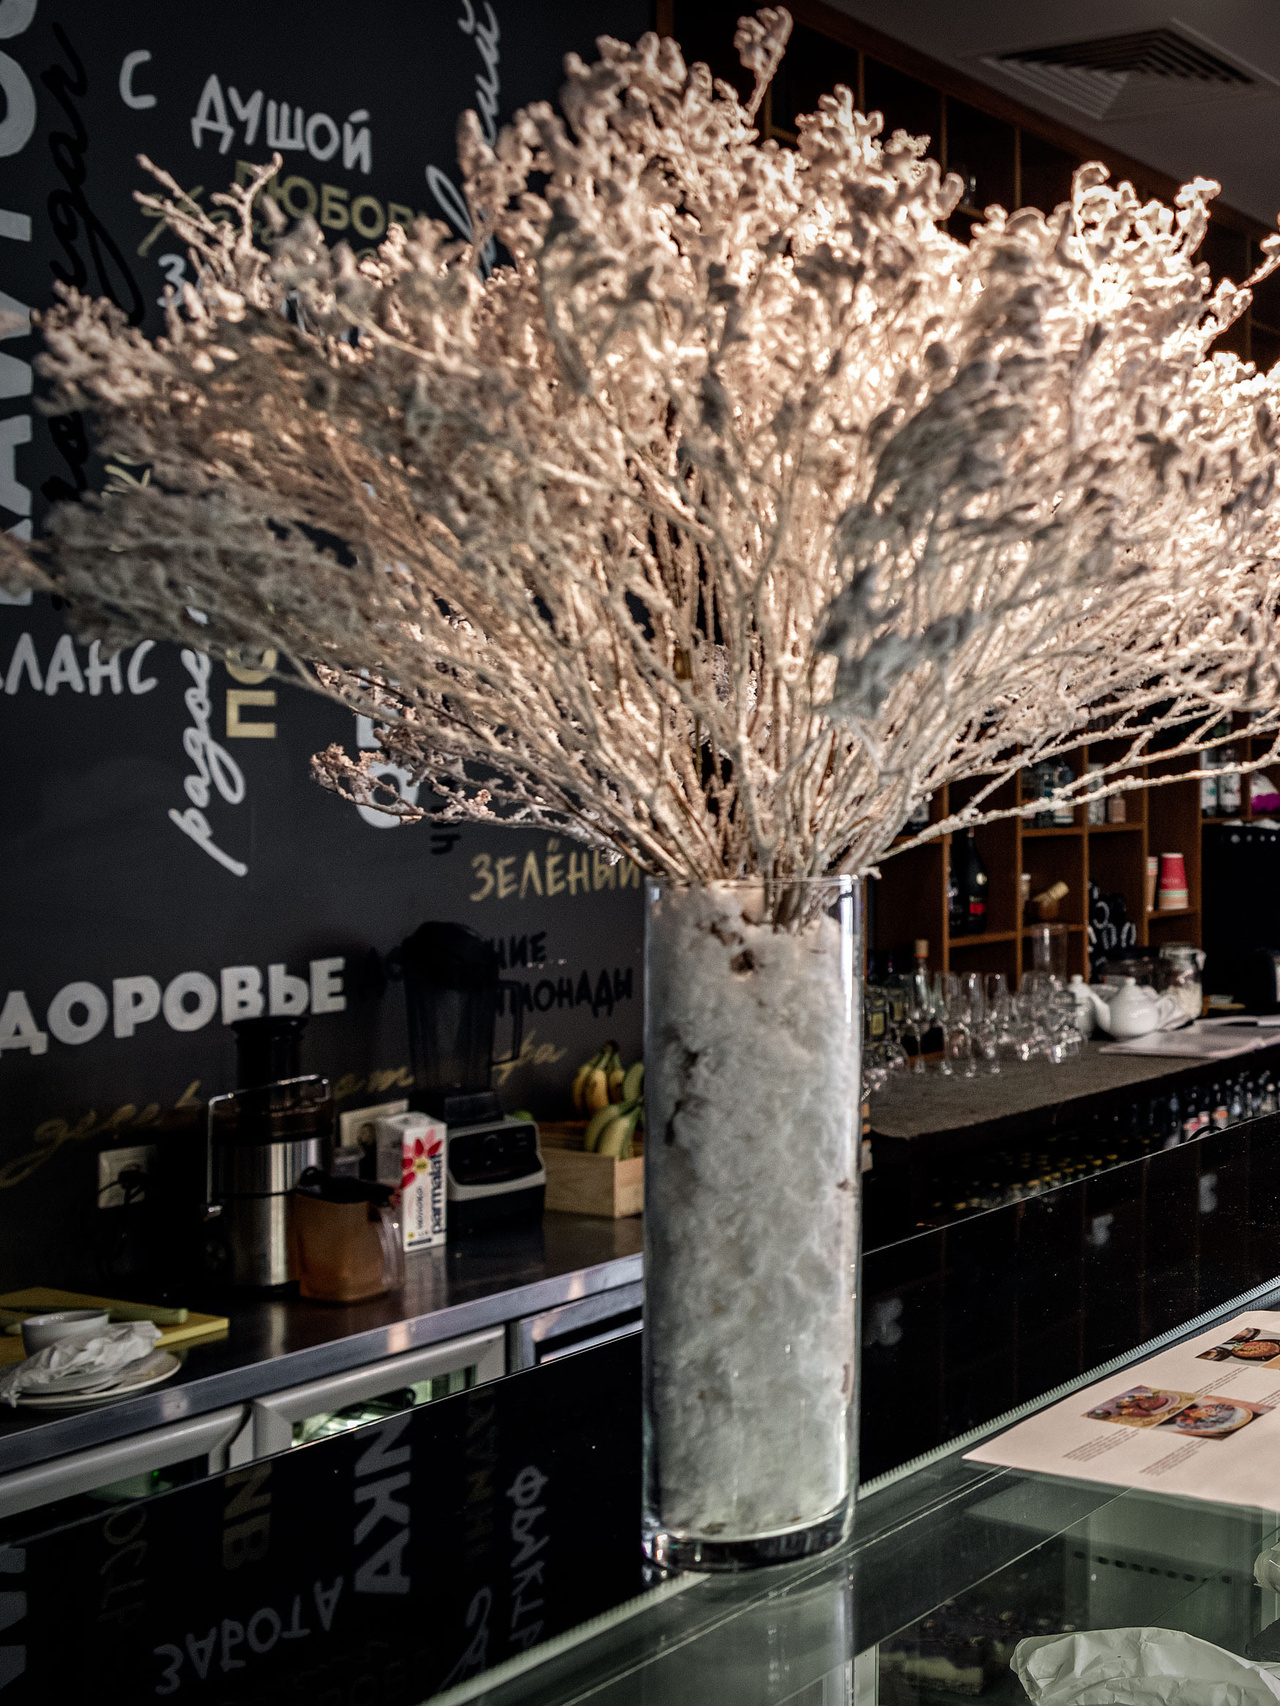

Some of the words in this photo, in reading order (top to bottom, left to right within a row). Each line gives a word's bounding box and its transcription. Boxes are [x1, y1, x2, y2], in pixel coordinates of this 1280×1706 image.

[190, 73, 372, 174] ДУШОЙ
[234, 158, 424, 240] ЛЮБОВ
[0, 632, 160, 697] ЛАНС
[168, 640, 248, 877] радос
[470, 839, 642, 902] ЗЕЛЁНЫЙ
[429, 1153, 447, 1234] parmalat
